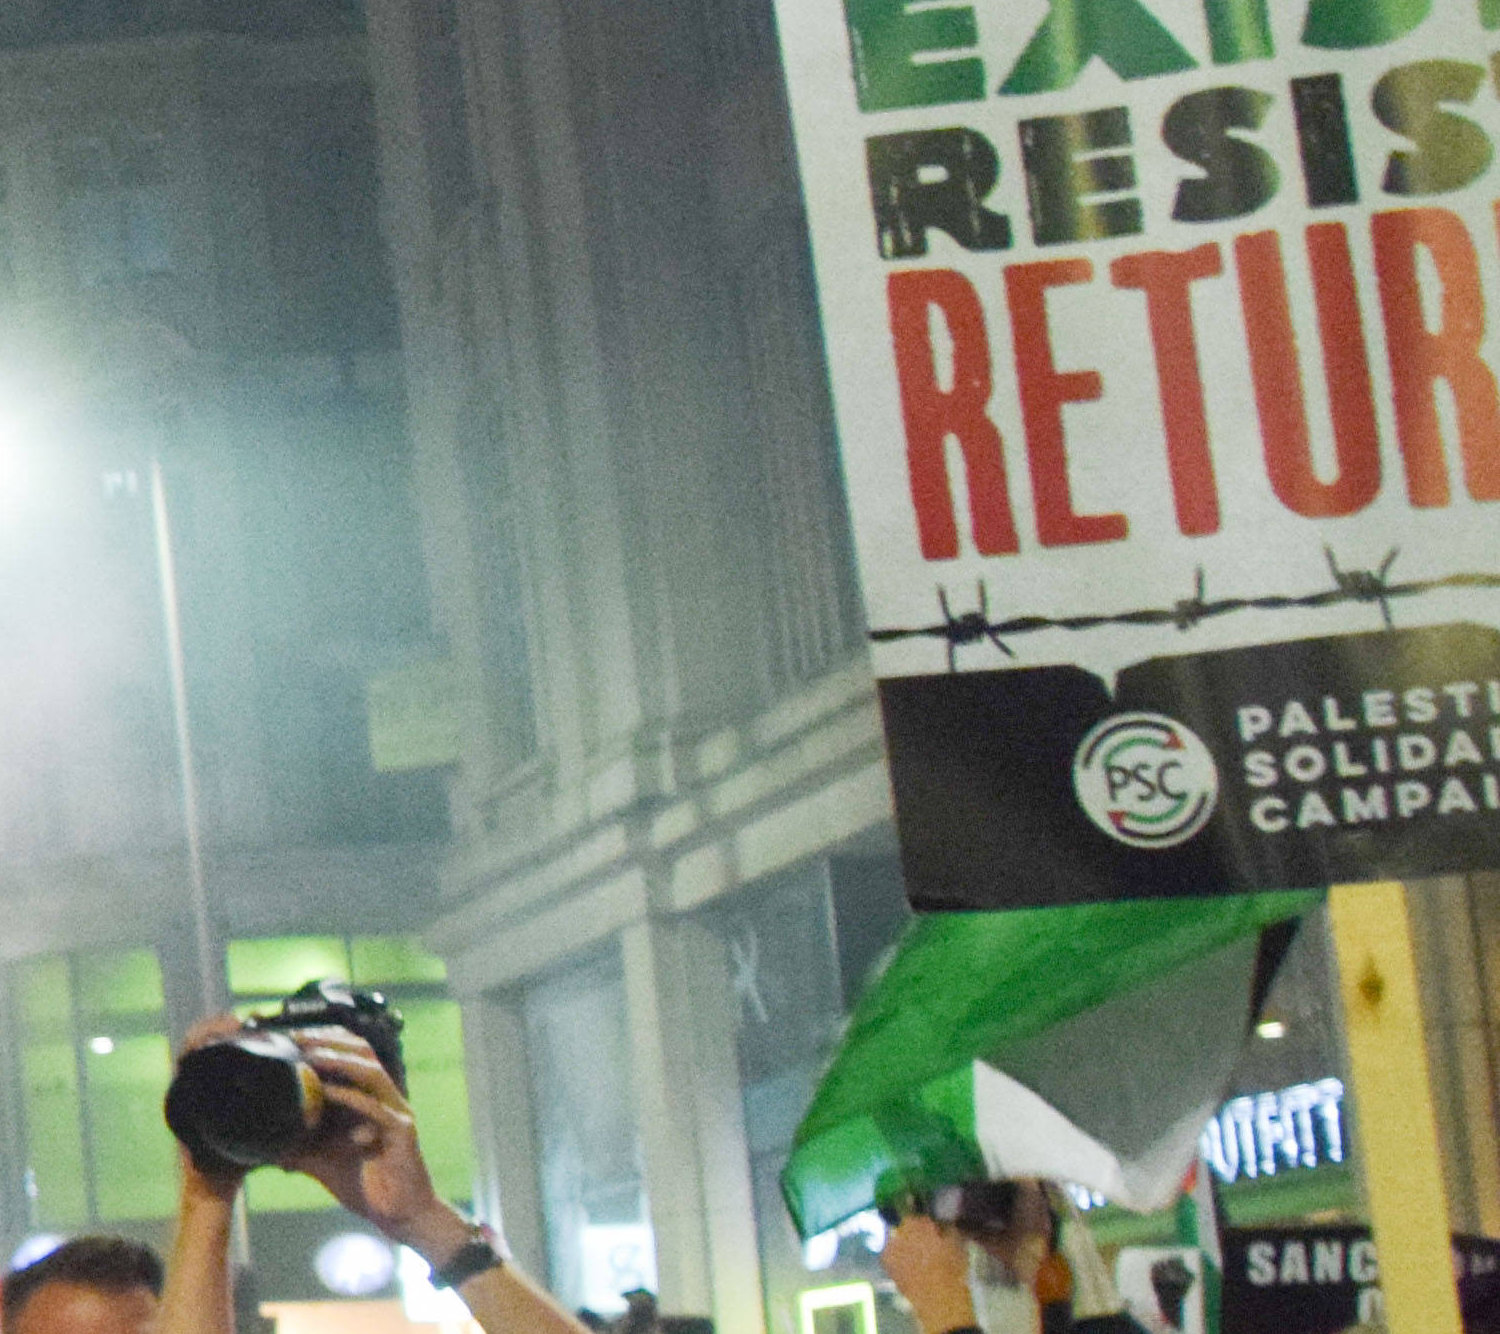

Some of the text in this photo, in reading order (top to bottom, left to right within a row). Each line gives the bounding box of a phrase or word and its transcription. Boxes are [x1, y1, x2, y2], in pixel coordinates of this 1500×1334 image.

[864, 51, 1500, 260] RESIS
[886, 197, 1500, 561] RETUR
[1106, 762, 1187, 802] PSC
